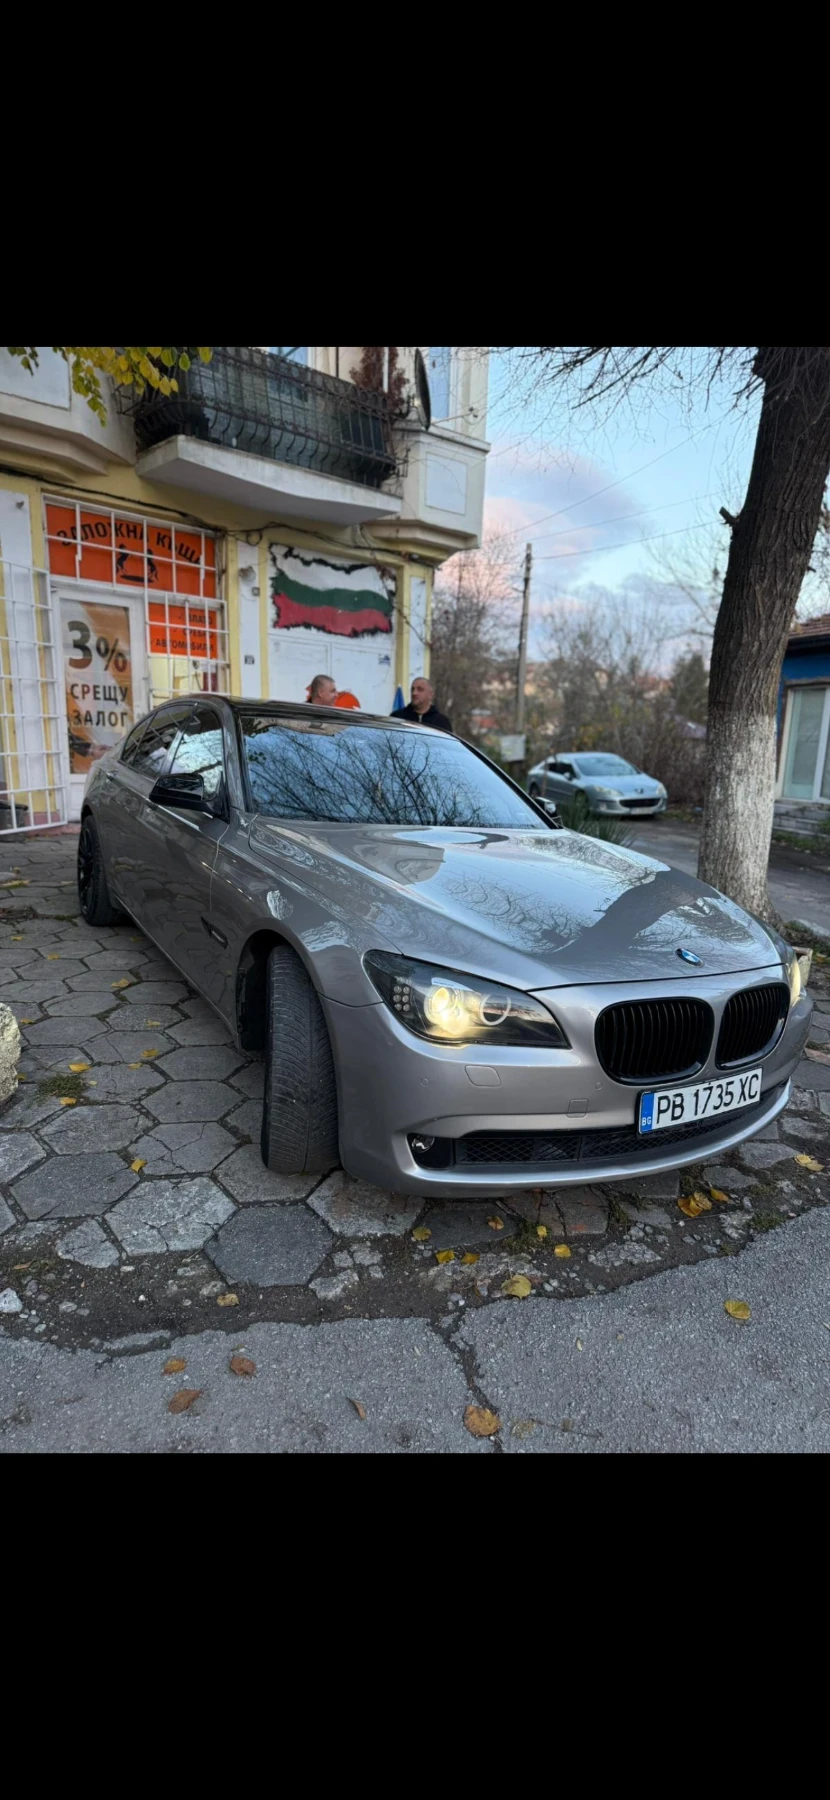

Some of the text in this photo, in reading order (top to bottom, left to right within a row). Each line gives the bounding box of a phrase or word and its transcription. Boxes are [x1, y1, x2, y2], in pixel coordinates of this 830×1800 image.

[67, 620, 127, 673] 3%
[70, 683, 129, 705] СРЕЩУ
[73, 710, 128, 727] ЗАЛОГ
[693, 1081, 735, 1116] 1735
[641, 1116, 652, 1126] BG
